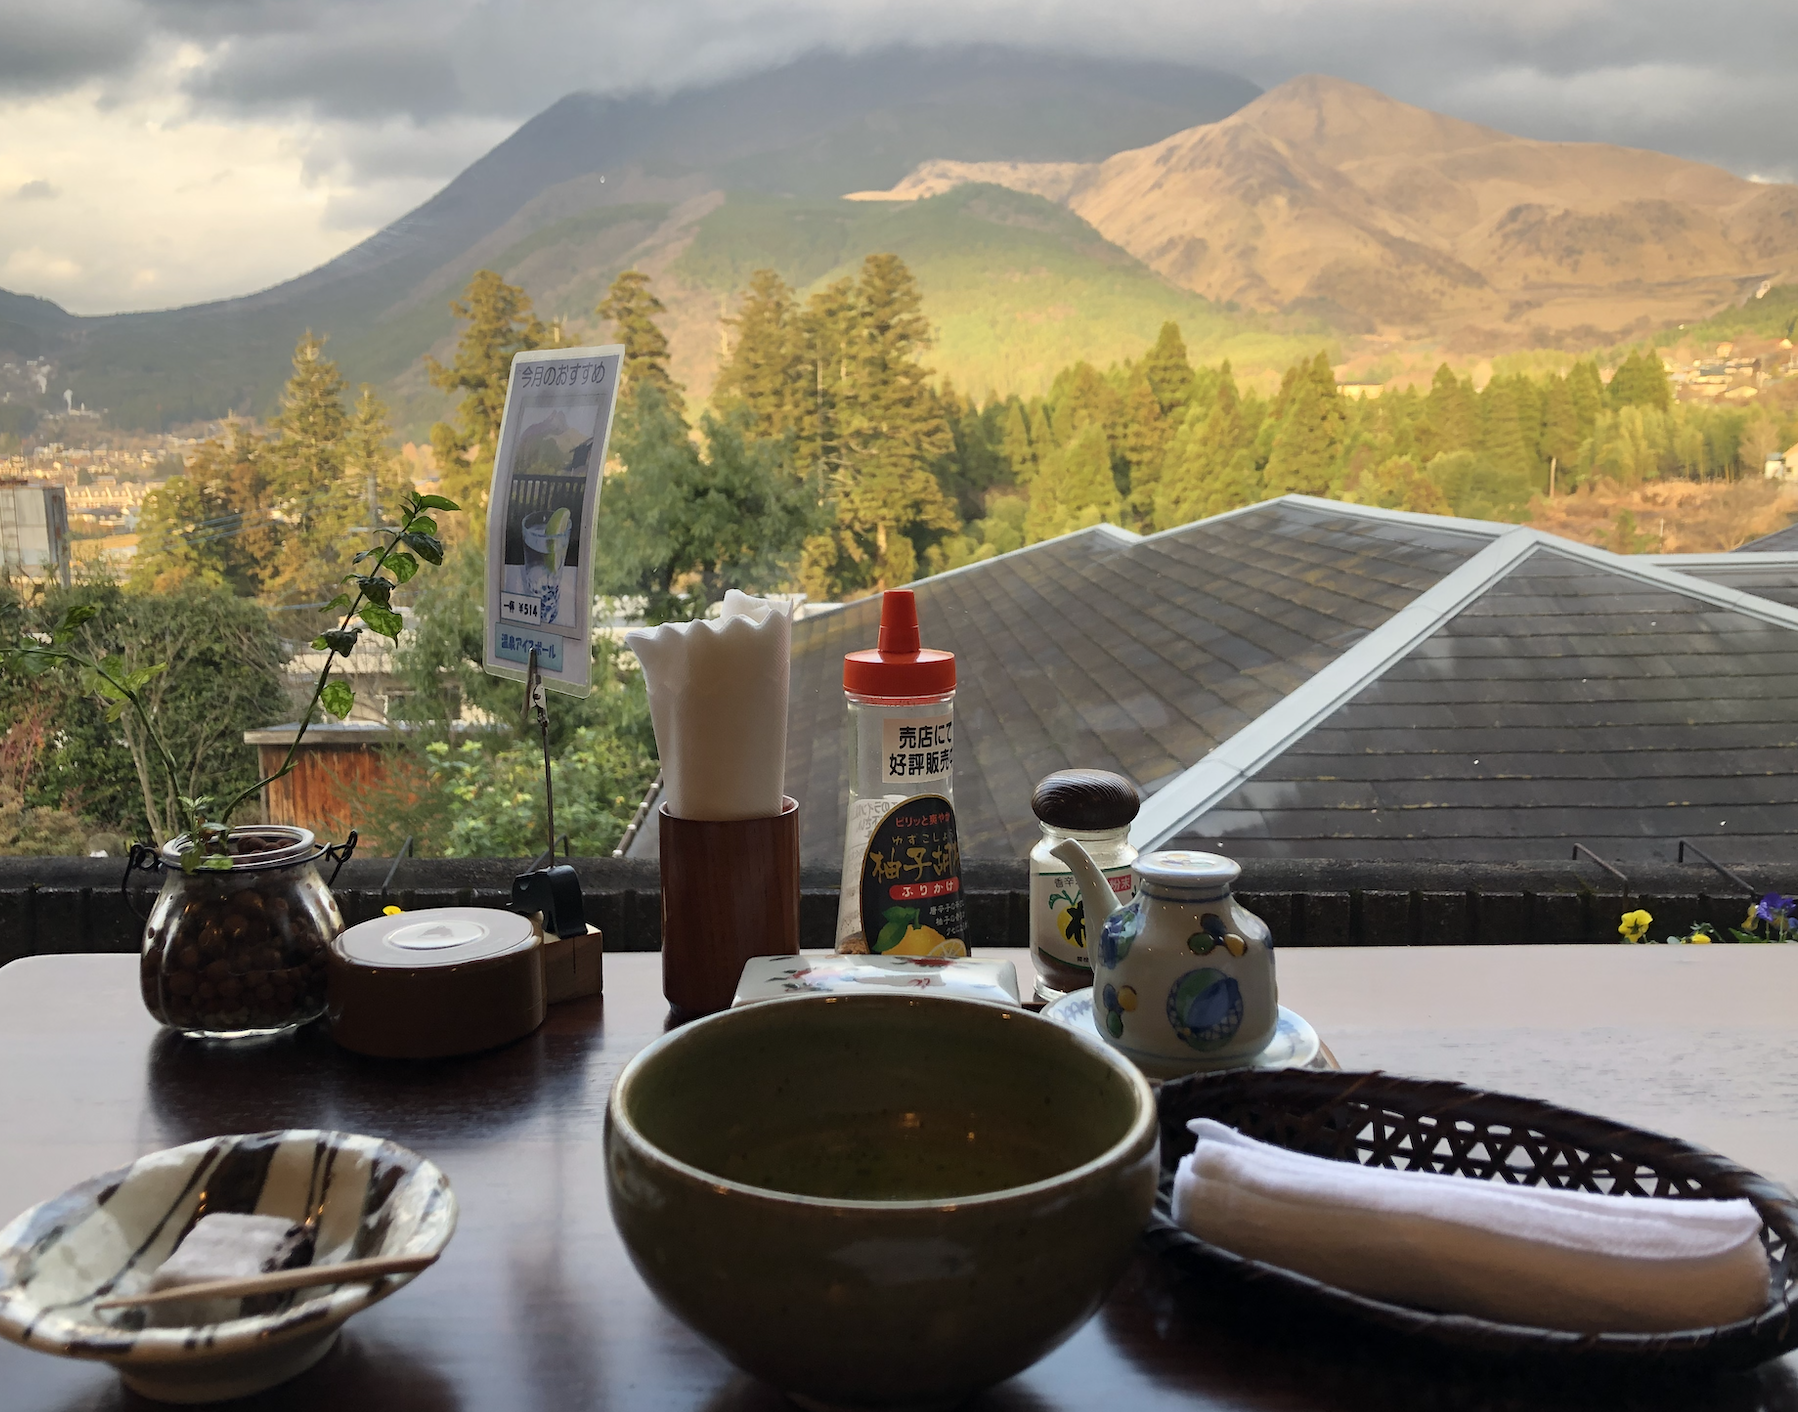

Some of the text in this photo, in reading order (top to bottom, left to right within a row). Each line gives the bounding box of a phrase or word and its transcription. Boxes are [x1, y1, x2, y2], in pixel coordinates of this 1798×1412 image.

[521, 361, 606, 388] 今月のおすすめ
[518, 602, 538, 617] ¥514
[899, 721, 953, 749] 売店にて
[901, 880, 954, 898] ふりかけ
[1054, 876, 1079, 888] 香辛
[1109, 877, 1132, 891] 粉末
